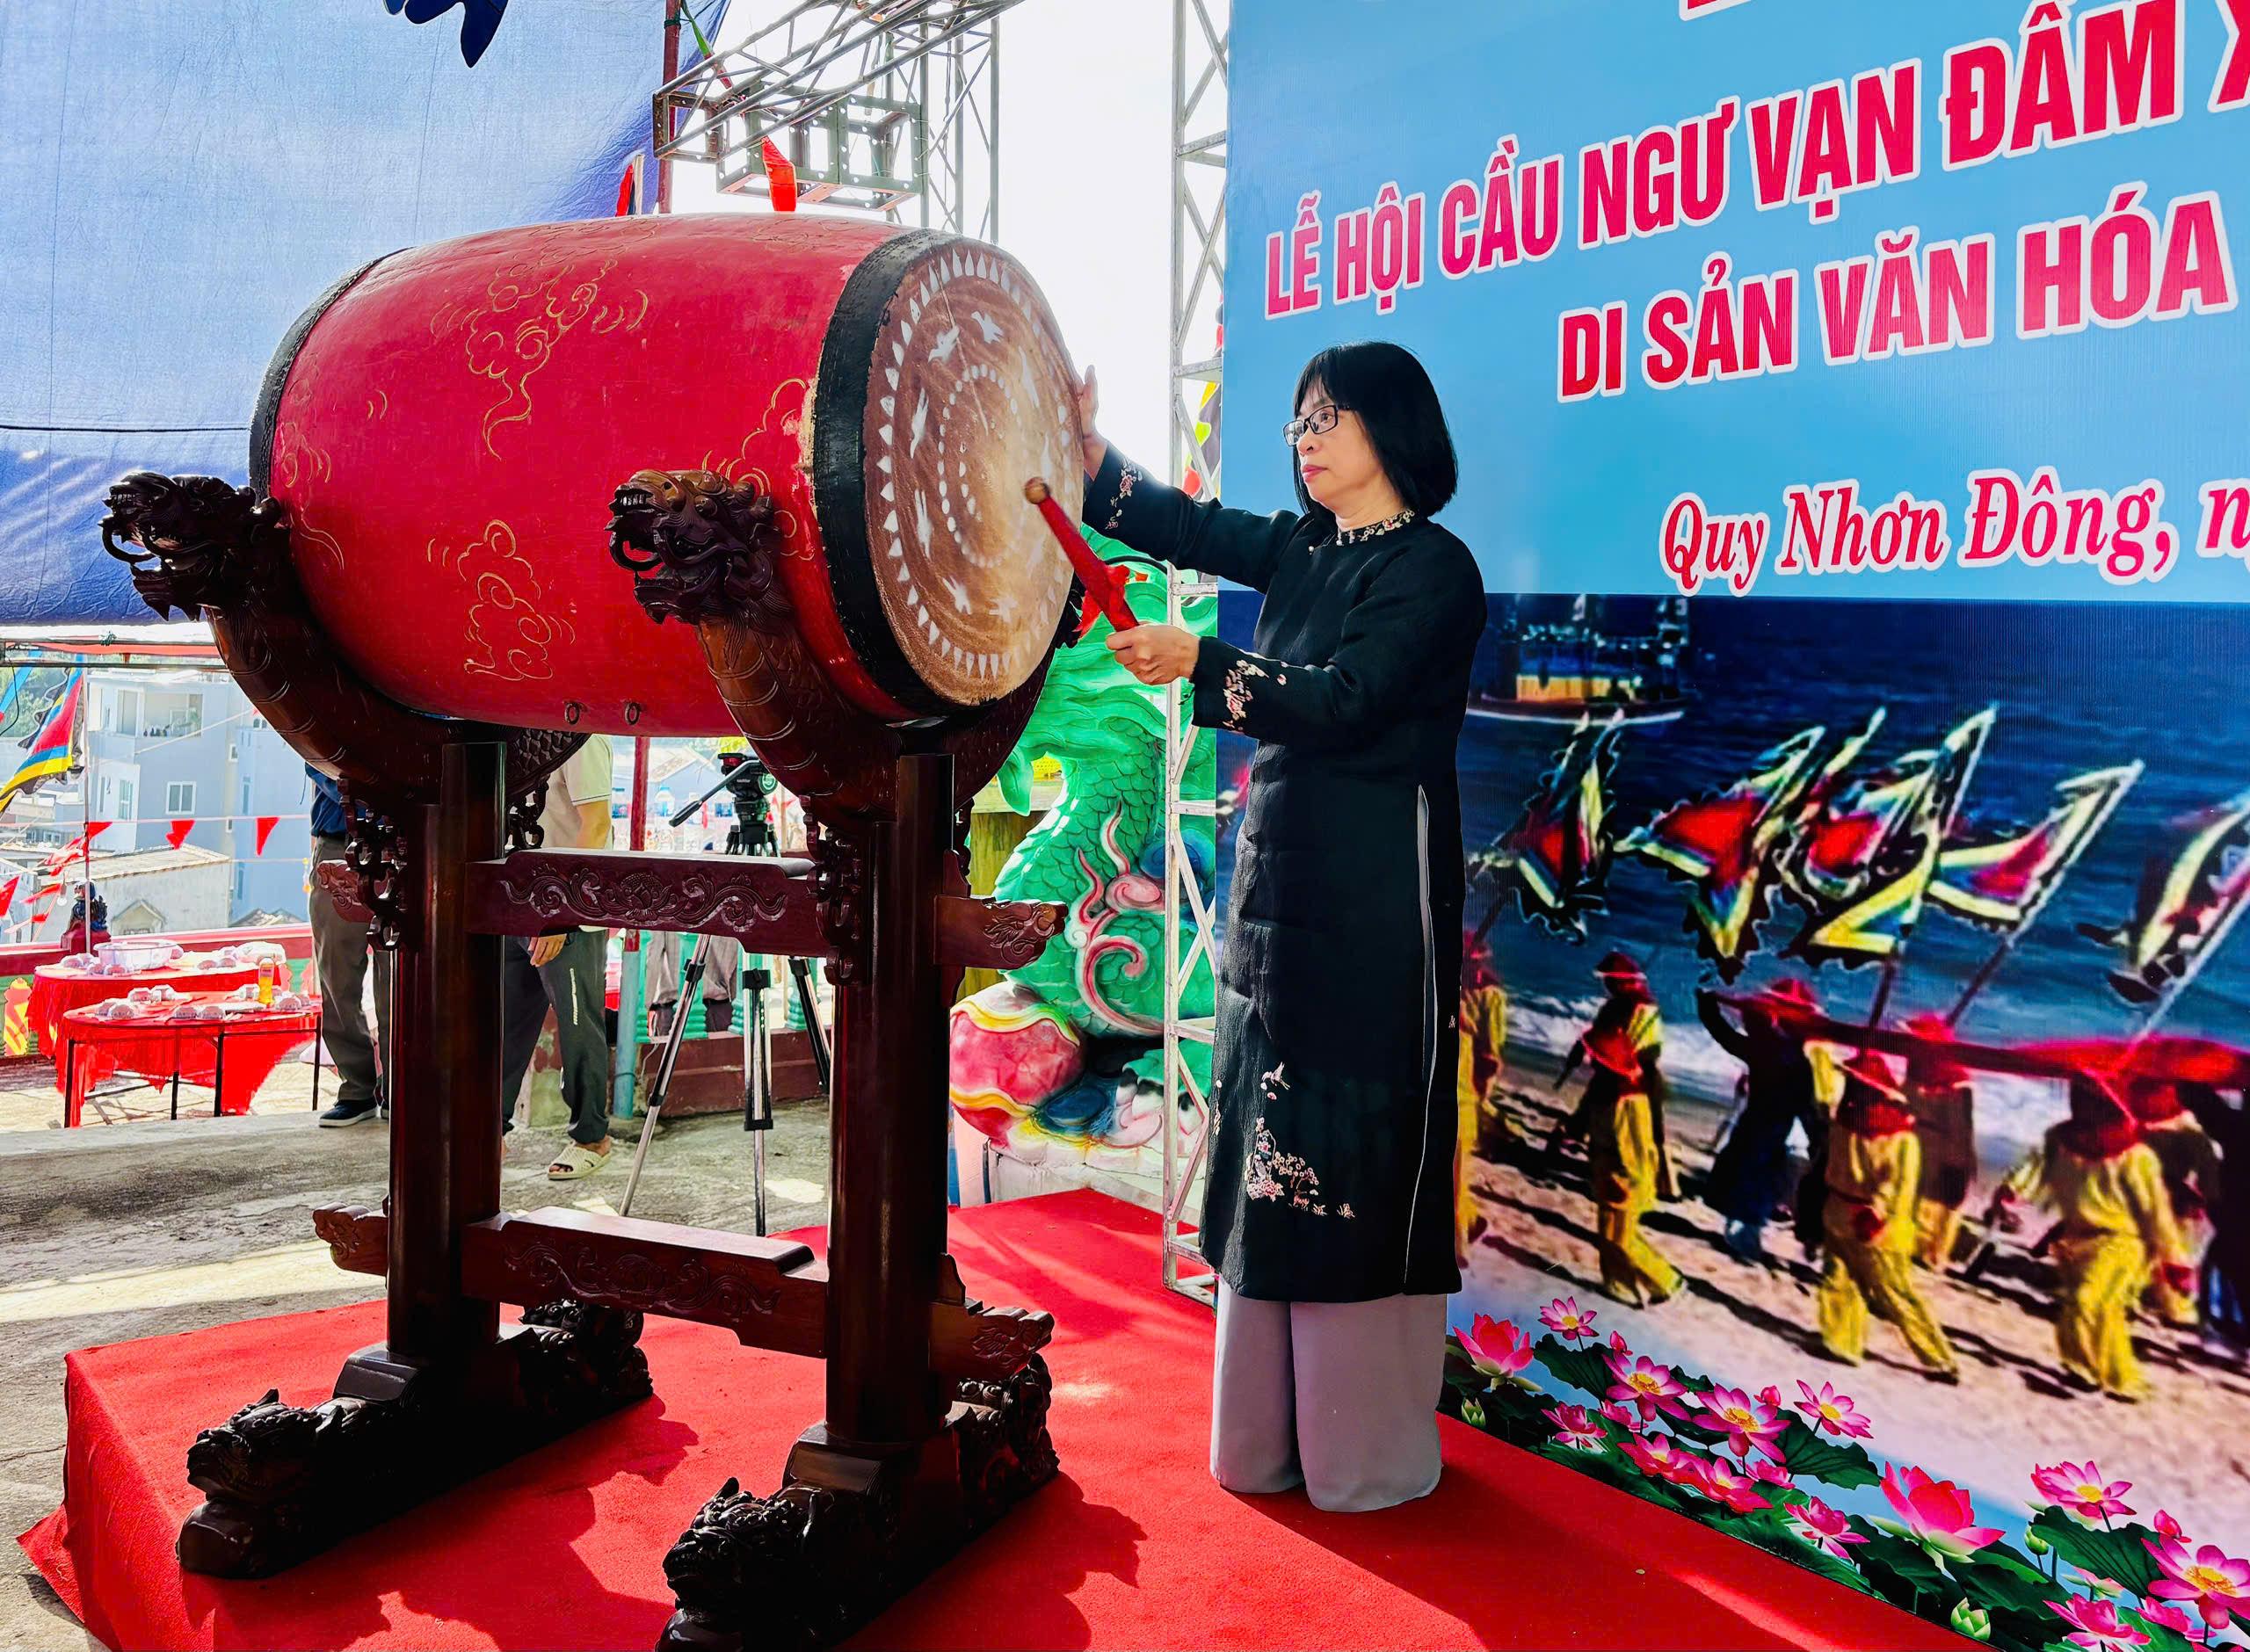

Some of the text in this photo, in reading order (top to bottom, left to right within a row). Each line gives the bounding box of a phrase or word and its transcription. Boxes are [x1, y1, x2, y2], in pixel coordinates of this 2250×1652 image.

[1267, 195, 1320, 317] LỄ
[1334, 185, 1423, 312] HỘI
[1440, 138, 1561, 277] CẦU
[1580, 100, 1737, 246] NGƯ
[1748, 62, 1918, 220] VẠN
[1560, 186, 2232, 399] DI SẢN VĂN HÓA
[1662, 496, 1767, 593] Quy
[1778, 482, 1946, 571] Nhơn
[1962, 470, 2174, 580] Đông,
